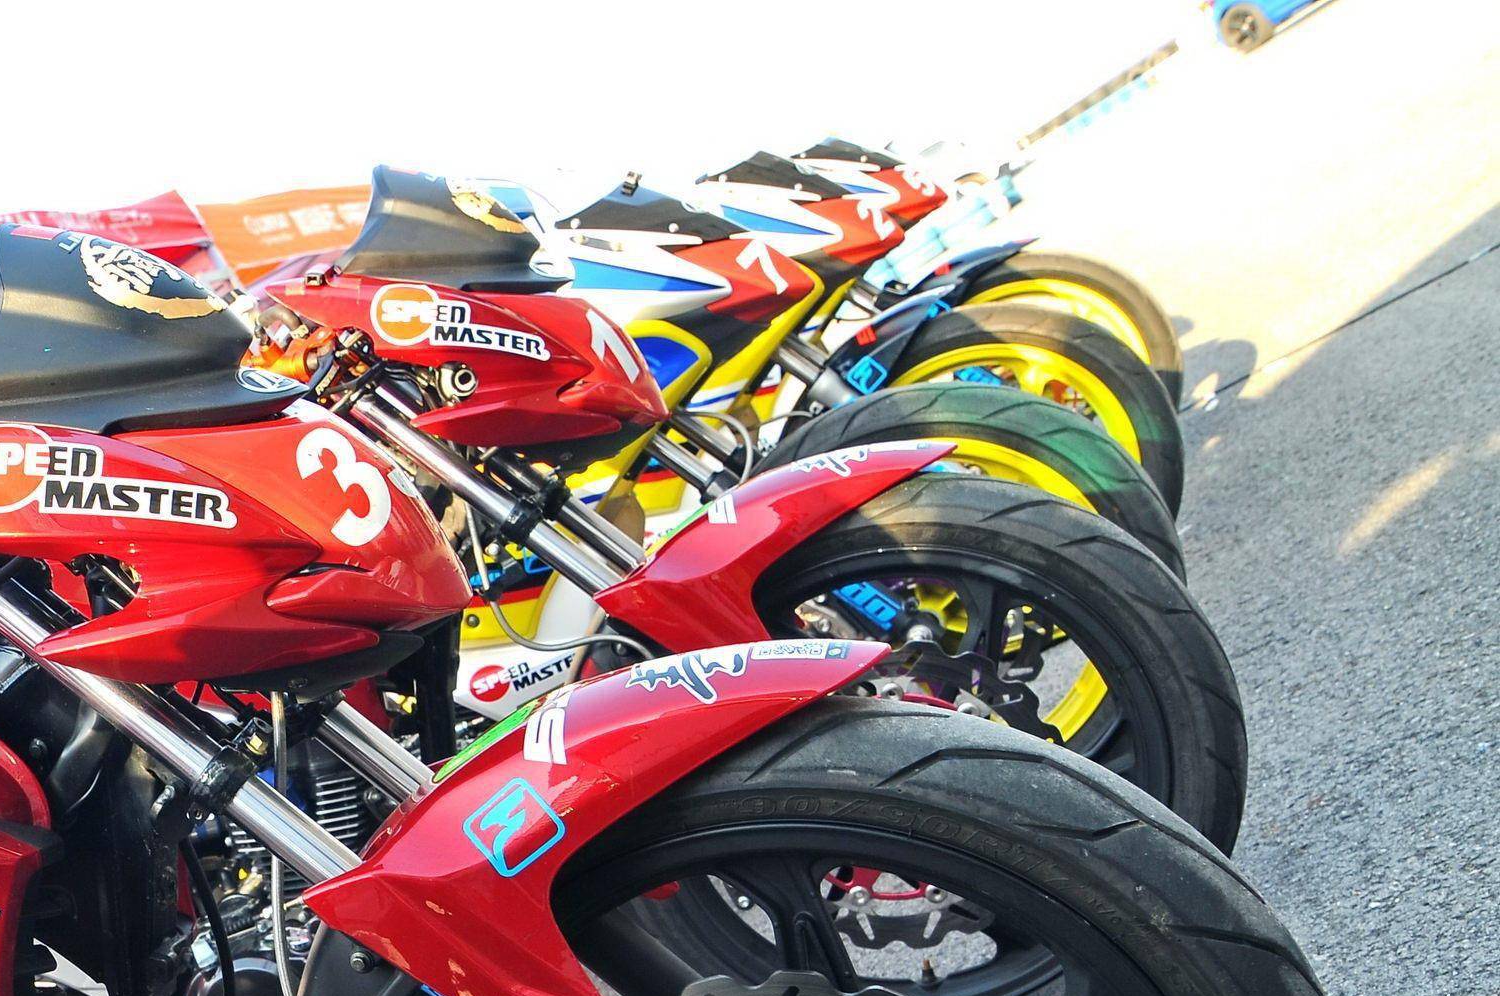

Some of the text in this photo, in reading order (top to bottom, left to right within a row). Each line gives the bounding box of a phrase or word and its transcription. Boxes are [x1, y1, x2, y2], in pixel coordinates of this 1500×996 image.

[381, 299, 467, 324] SPEED
[434, 325, 542, 356] MASTER
[43, 480, 223, 522] MASTER
[296, 427, 392, 547] 3
[473, 661, 530, 695] SPEED
